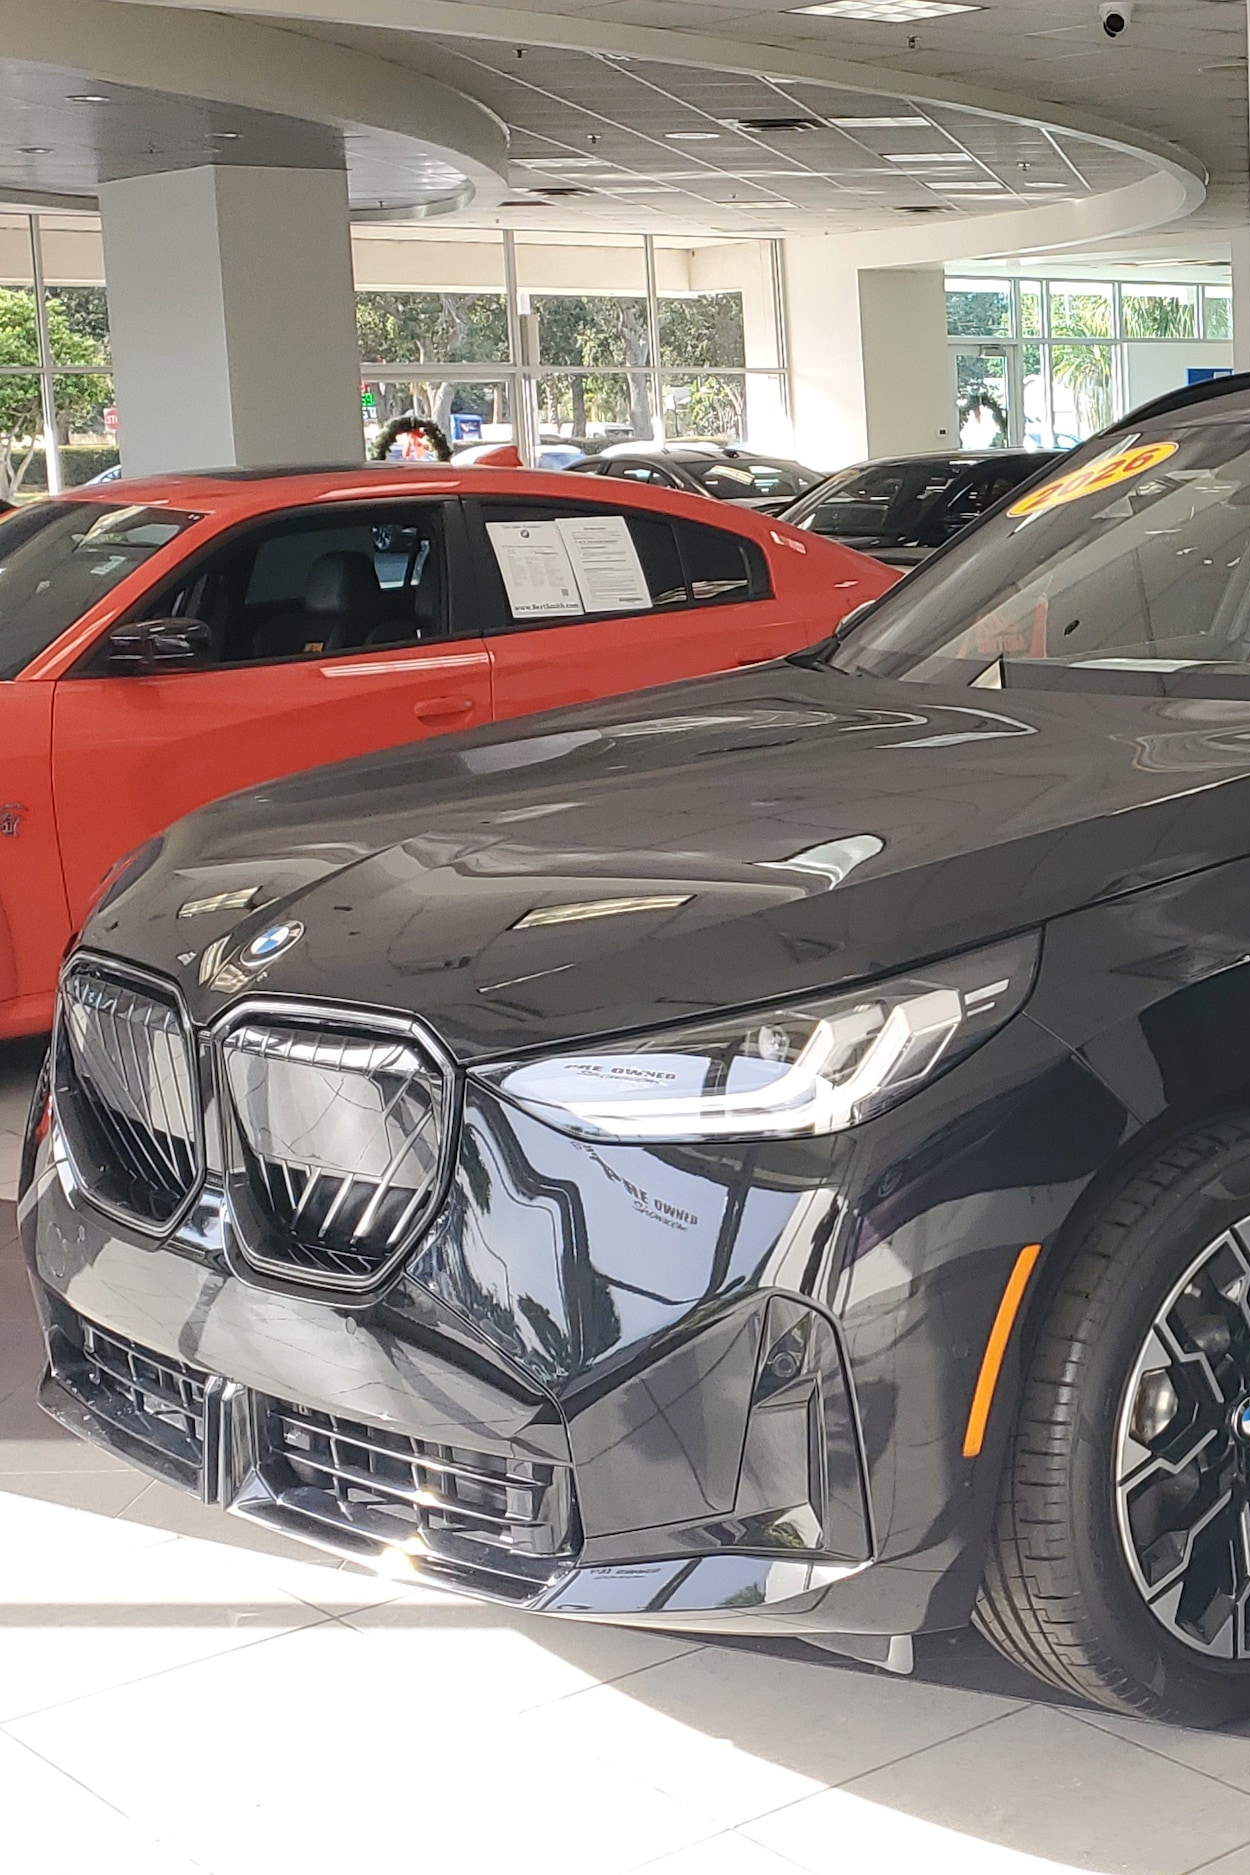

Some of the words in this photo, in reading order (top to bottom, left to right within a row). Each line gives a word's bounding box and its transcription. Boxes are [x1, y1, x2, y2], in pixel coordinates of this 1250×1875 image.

[1023, 448, 1160, 511] 2026
[611, 1067, 677, 1080] OWNED
[653, 1198, 699, 1226] OWNED
